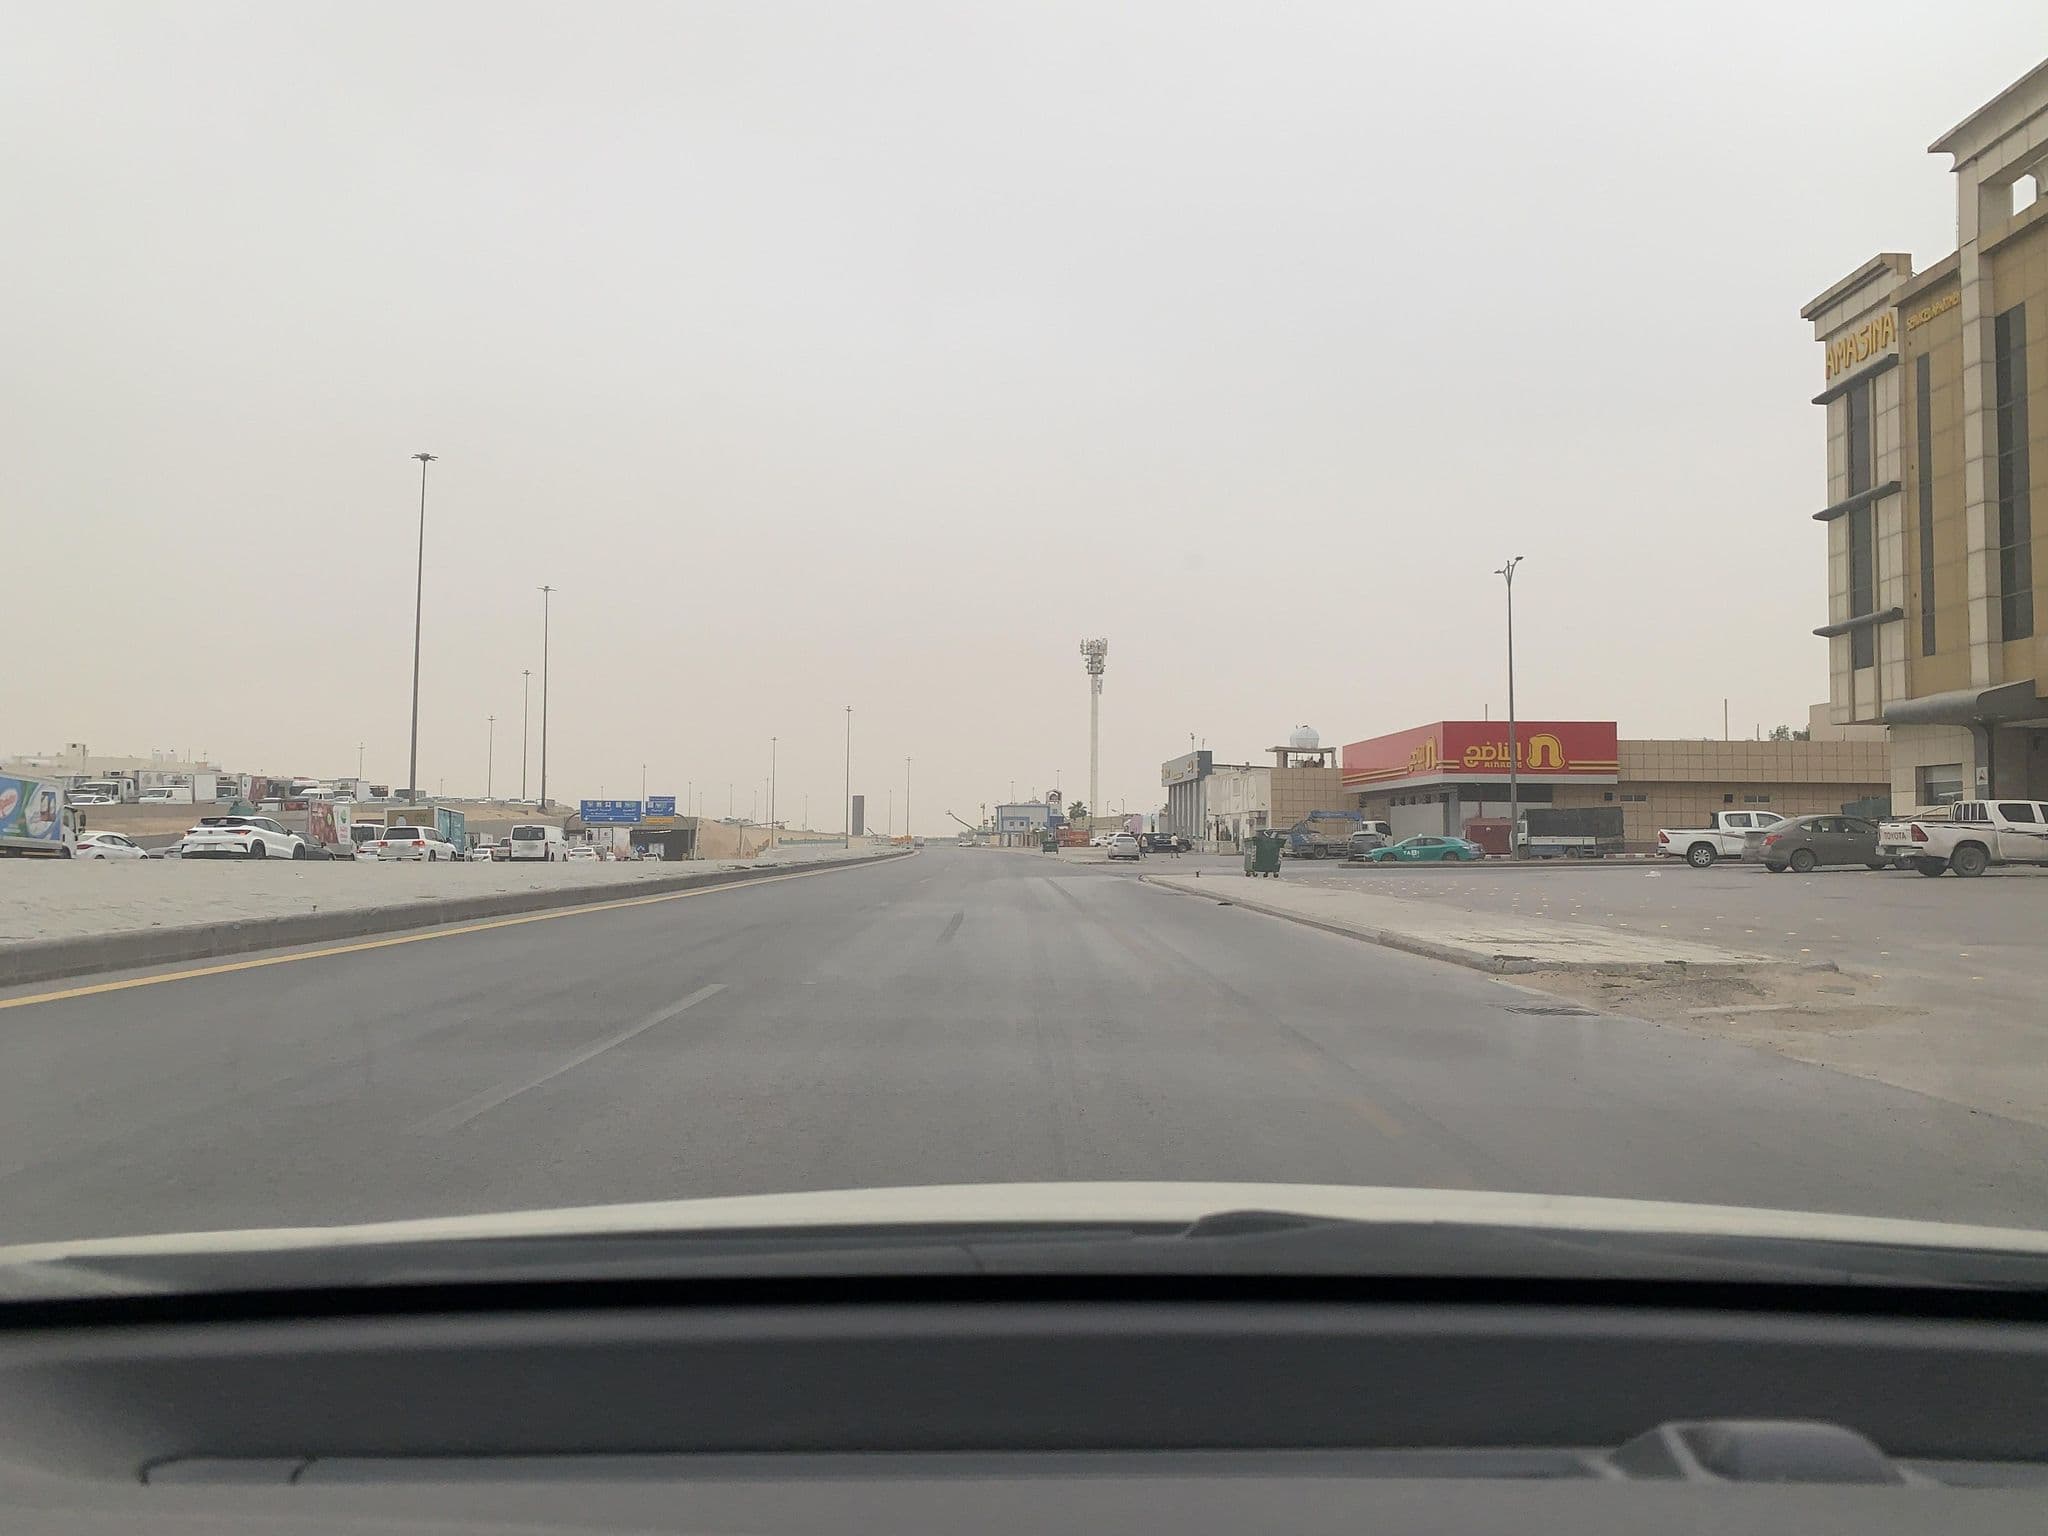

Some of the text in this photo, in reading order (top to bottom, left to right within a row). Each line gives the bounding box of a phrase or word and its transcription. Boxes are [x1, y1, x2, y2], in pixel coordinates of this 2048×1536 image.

[1826, 312, 1896, 379] AMASINA
[1463, 741, 1522, 768] اناضج
[1883, 831, 1907, 841] TOYOTA
